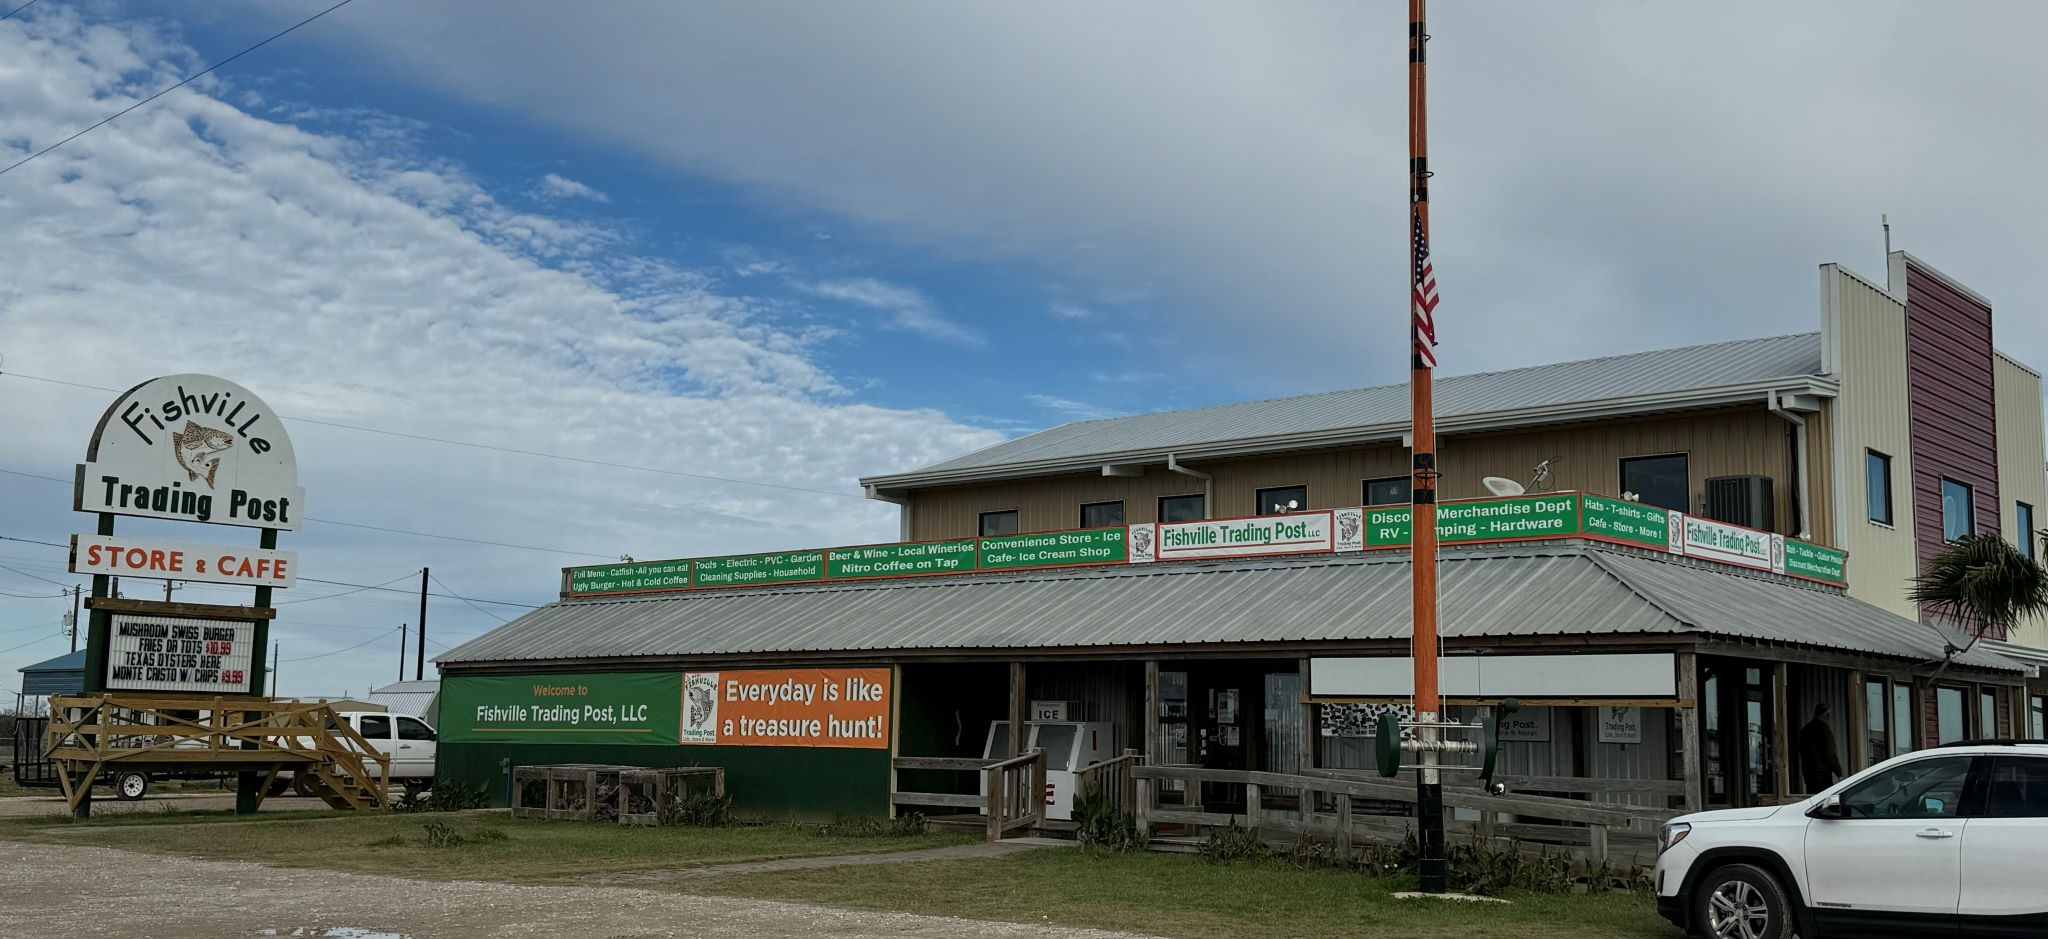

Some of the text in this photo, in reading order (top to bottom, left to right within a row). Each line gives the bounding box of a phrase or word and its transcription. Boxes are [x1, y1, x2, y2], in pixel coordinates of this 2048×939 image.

[101, 475, 289, 523] Trading Post
[1372, 499, 1572, 524] Disco Merchandise Dept
[1585, 499, 1604, 511] Hats
[1611, 504, 1640, 518] T-shirts
[1646, 512, 1665, 523] Gifts
[1163, 521, 1321, 547] Fishville Trading Post LLC
[1380, 527, 1400, 539] RV
[1490, 517, 1563, 532] Hardware
[1589, 516, 1606, 528] Cafe
[1613, 521, 1633, 533] Store
[1639, 526, 1657, 538] More
[981, 537, 1056, 550] Convenience
[1060, 534, 1092, 545] Store
[1103, 532, 1121, 541] Ice
[1686, 522, 1760, 555] Fishville Trading Post
[829, 552, 851, 560] Beer
[853, 550, 861, 559] &
[863, 549, 888, 559] Wine
[898, 545, 925, 556] Local
[927, 543, 974, 554] Wineries
[1019, 552, 1036, 561] Ice
[1039, 549, 1076, 559] Cream
[1079, 547, 1111, 558] Shop
[87, 544, 288, 579] STORE & CAFE
[695, 560, 717, 570] Tools
[726, 558, 757, 568] Electric
[765, 556, 783, 565] PVC
[790, 553, 823, 563] Garden
[842, 558, 959, 573] Nitro Coffee on Tap
[573, 571, 586, 579] Full
[587, 570, 605, 578] Menu
[610, 568, 634, 577] Catfish
[648, 567, 662, 576] you
[663, 565, 675, 573] can
[677, 564, 688, 572] eat
[700, 572, 733, 582] Cleaning
[734, 570, 767, 580] Supplies
[773, 566, 816, 577] Household
[573, 583, 589, 592] Ugly
[590, 581, 615, 590] Burger
[621, 580, 635, 588] Hot
[643, 577, 661, 586] Cold
[663, 576, 688, 585] Coffee
[119, 622, 235, 642] MUSHROOM SWISS BURGER
[139, 638, 232, 655] FRIES OR TOTS $10.99
[125, 651, 222, 669] TEXAS OYSTERS HERE
[112, 665, 143, 680] MONTE
[146, 667, 177, 682] CRISTO
[194, 669, 219, 683] CHIPS
[221, 670, 243, 684] $9.99
[533, 684, 588, 697] Welcome to
[725, 677, 883, 706] Everyday is like
[476, 704, 648, 725] Fishville Trading Post, LLC
[1039, 710, 1059, 719] ICE
[684, 729, 715, 737] Trading Post
[722, 713, 883, 738] a treasure hunt!
